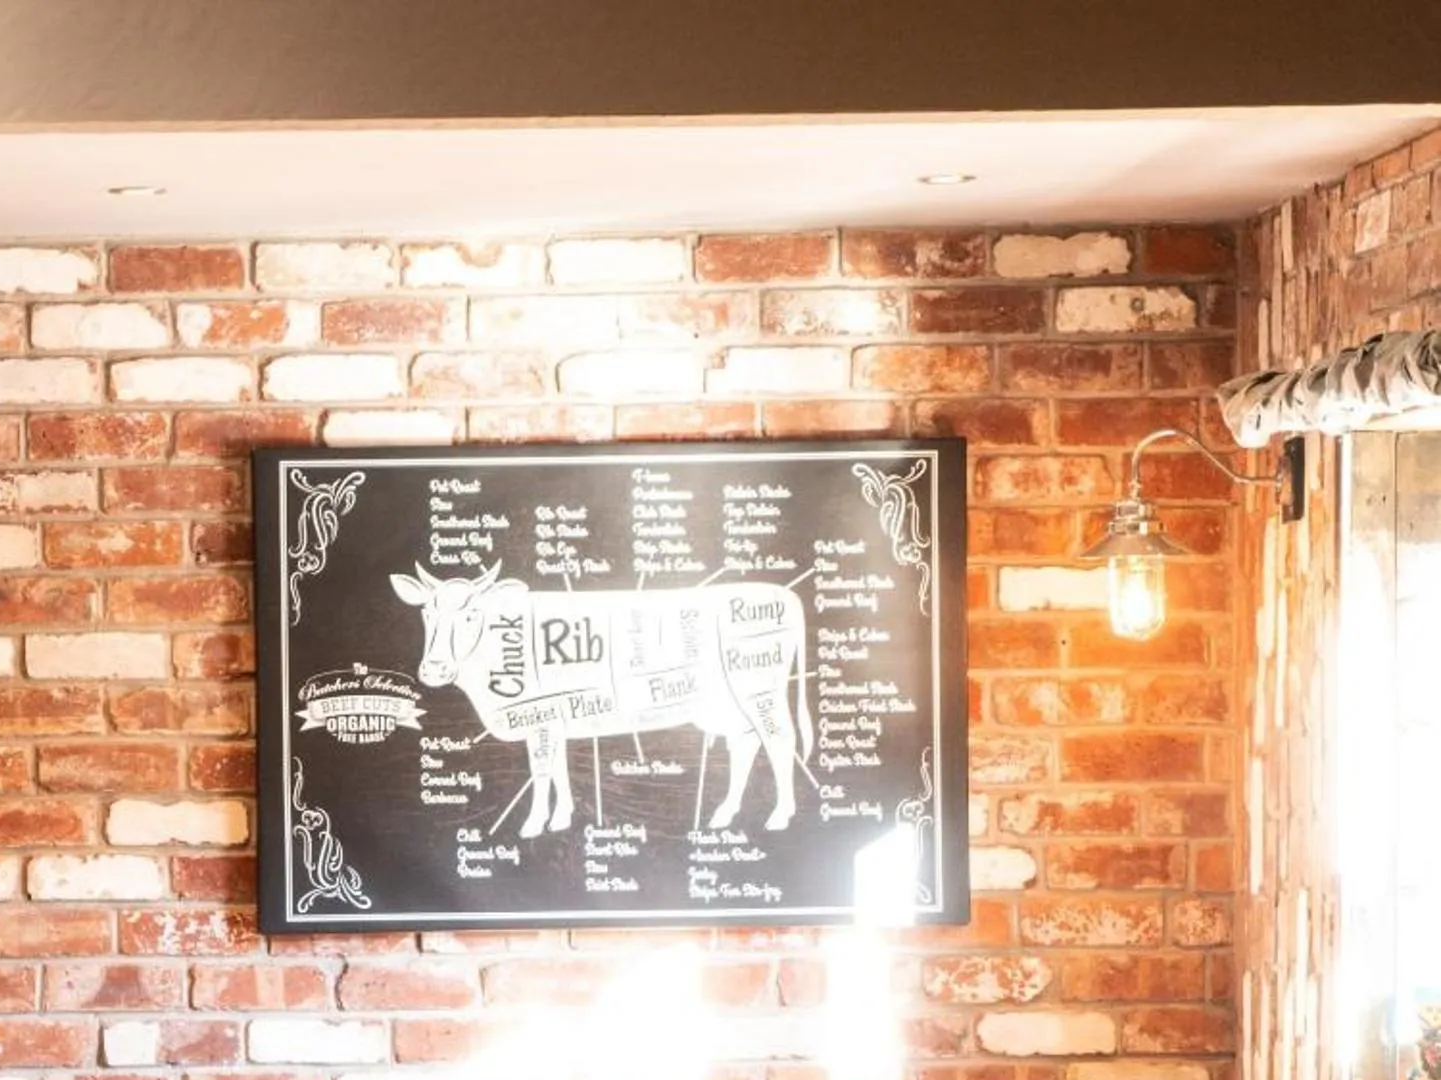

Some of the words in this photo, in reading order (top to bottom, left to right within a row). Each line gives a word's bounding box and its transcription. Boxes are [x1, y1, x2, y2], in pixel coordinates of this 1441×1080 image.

[729, 597, 786, 626] Rump
[488, 614, 525, 698] Chuck
[540, 617, 604, 666] Rib
[726, 642, 784, 673] Round
[649, 673, 698, 703] Flank
[321, 698, 359, 714] BEEF
[362, 697, 403, 713] CUTS
[567, 693, 613, 720] Plate
[326, 715, 396, 732] ORGANIC
